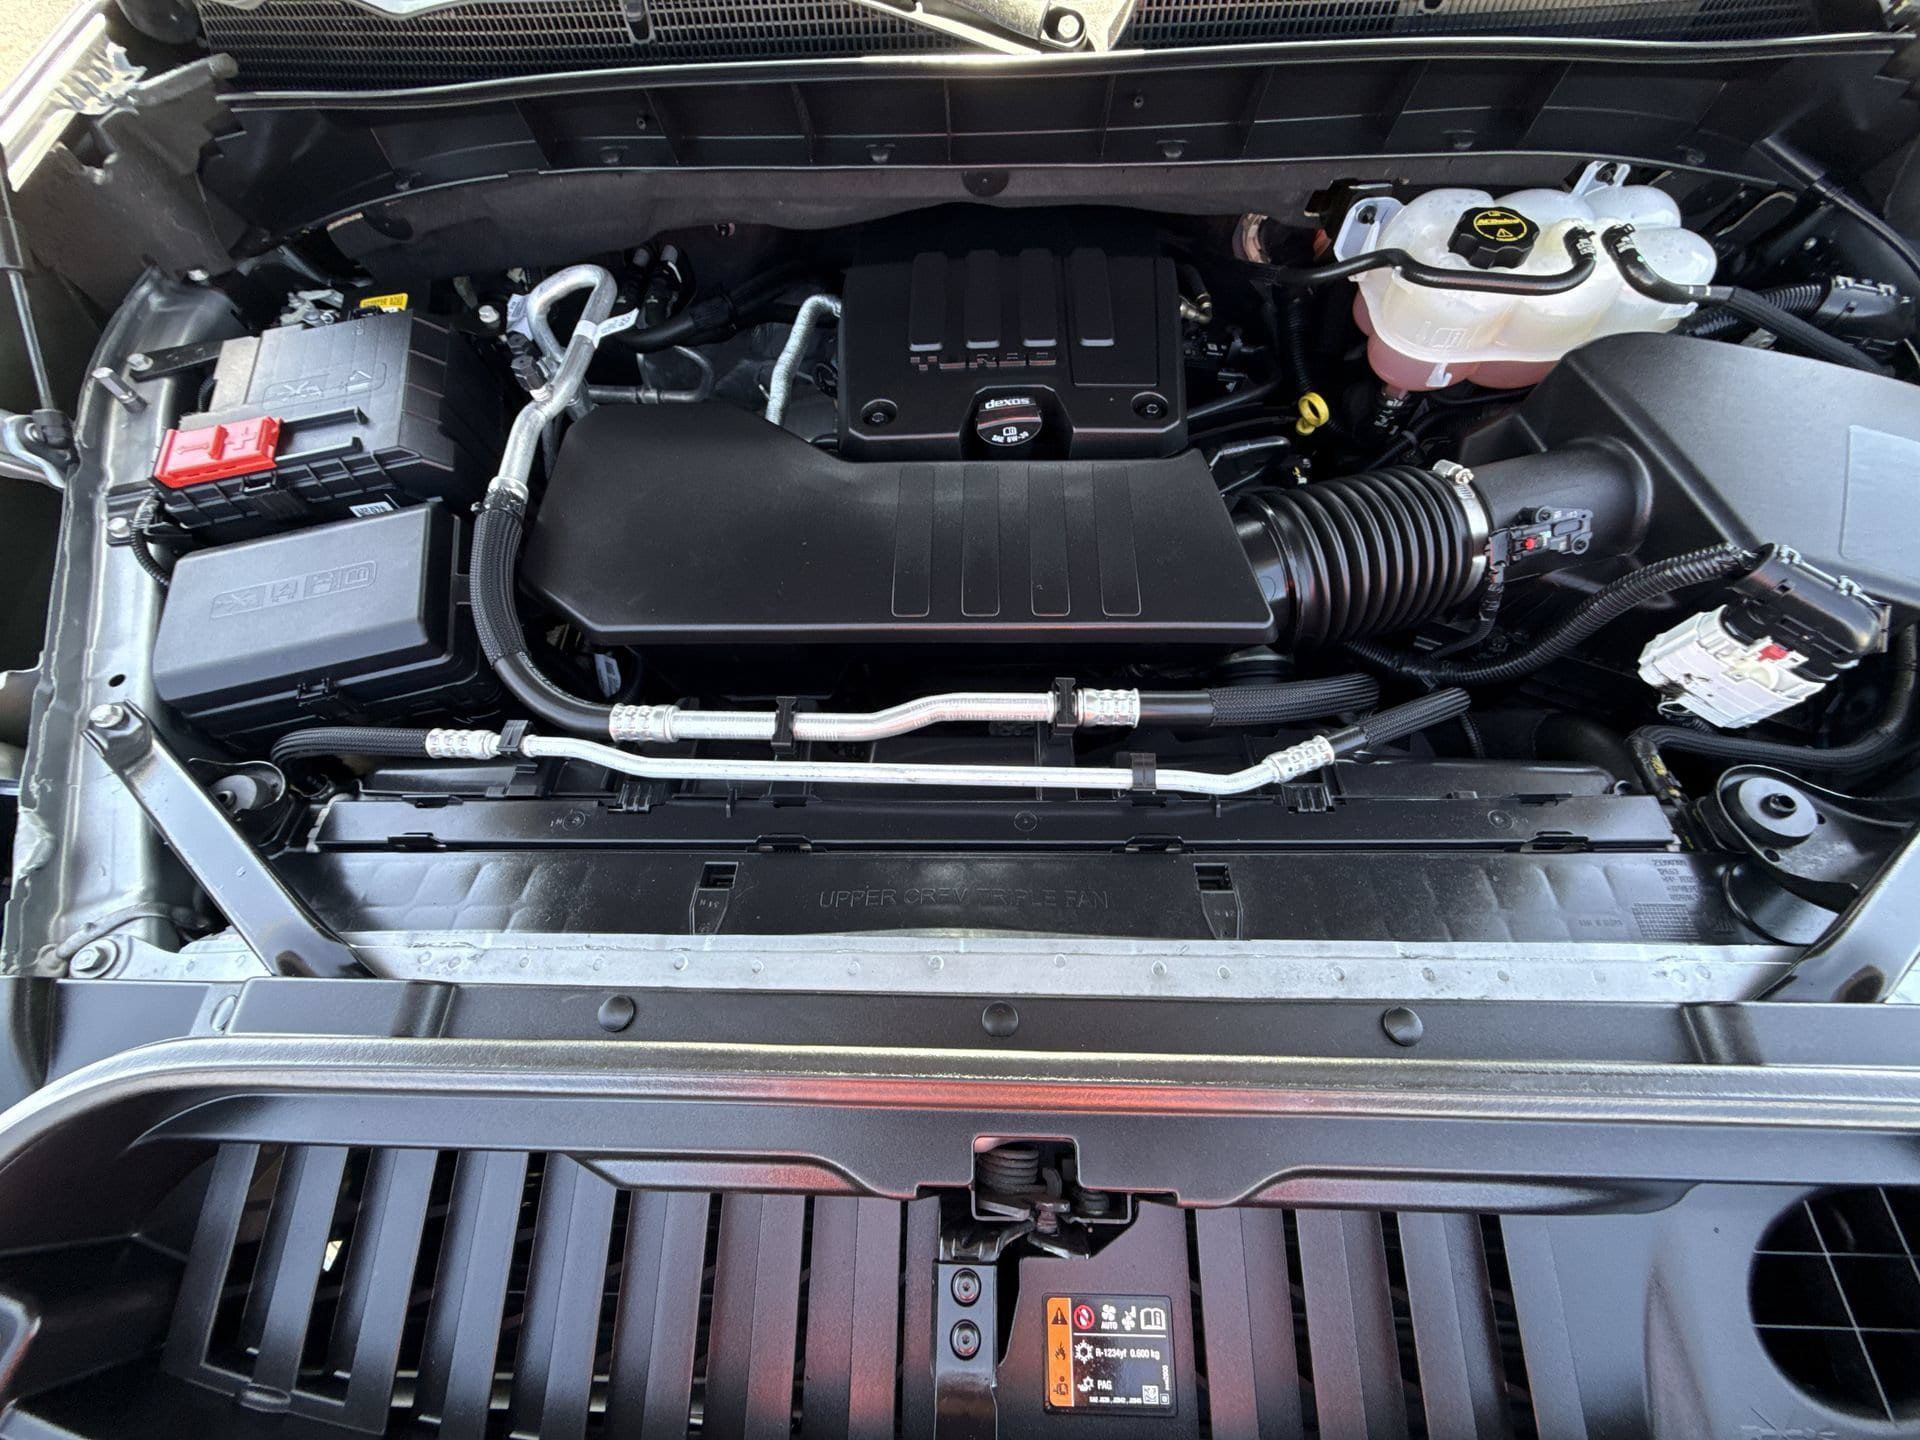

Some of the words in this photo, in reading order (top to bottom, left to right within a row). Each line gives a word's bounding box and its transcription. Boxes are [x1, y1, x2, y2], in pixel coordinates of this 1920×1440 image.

[985, 398, 1030, 409] dexos
[819, 888, 897, 908] UPPER
[975, 887, 1057, 906] TRIPLE
[1064, 888, 1109, 909] FAN
[1101, 1321, 1118, 1330] AUTO
[1095, 1347, 1127, 1360] R-1234yf
[1150, 1348, 1161, 1361] kg
[1097, 1379, 1113, 1390] PAG
